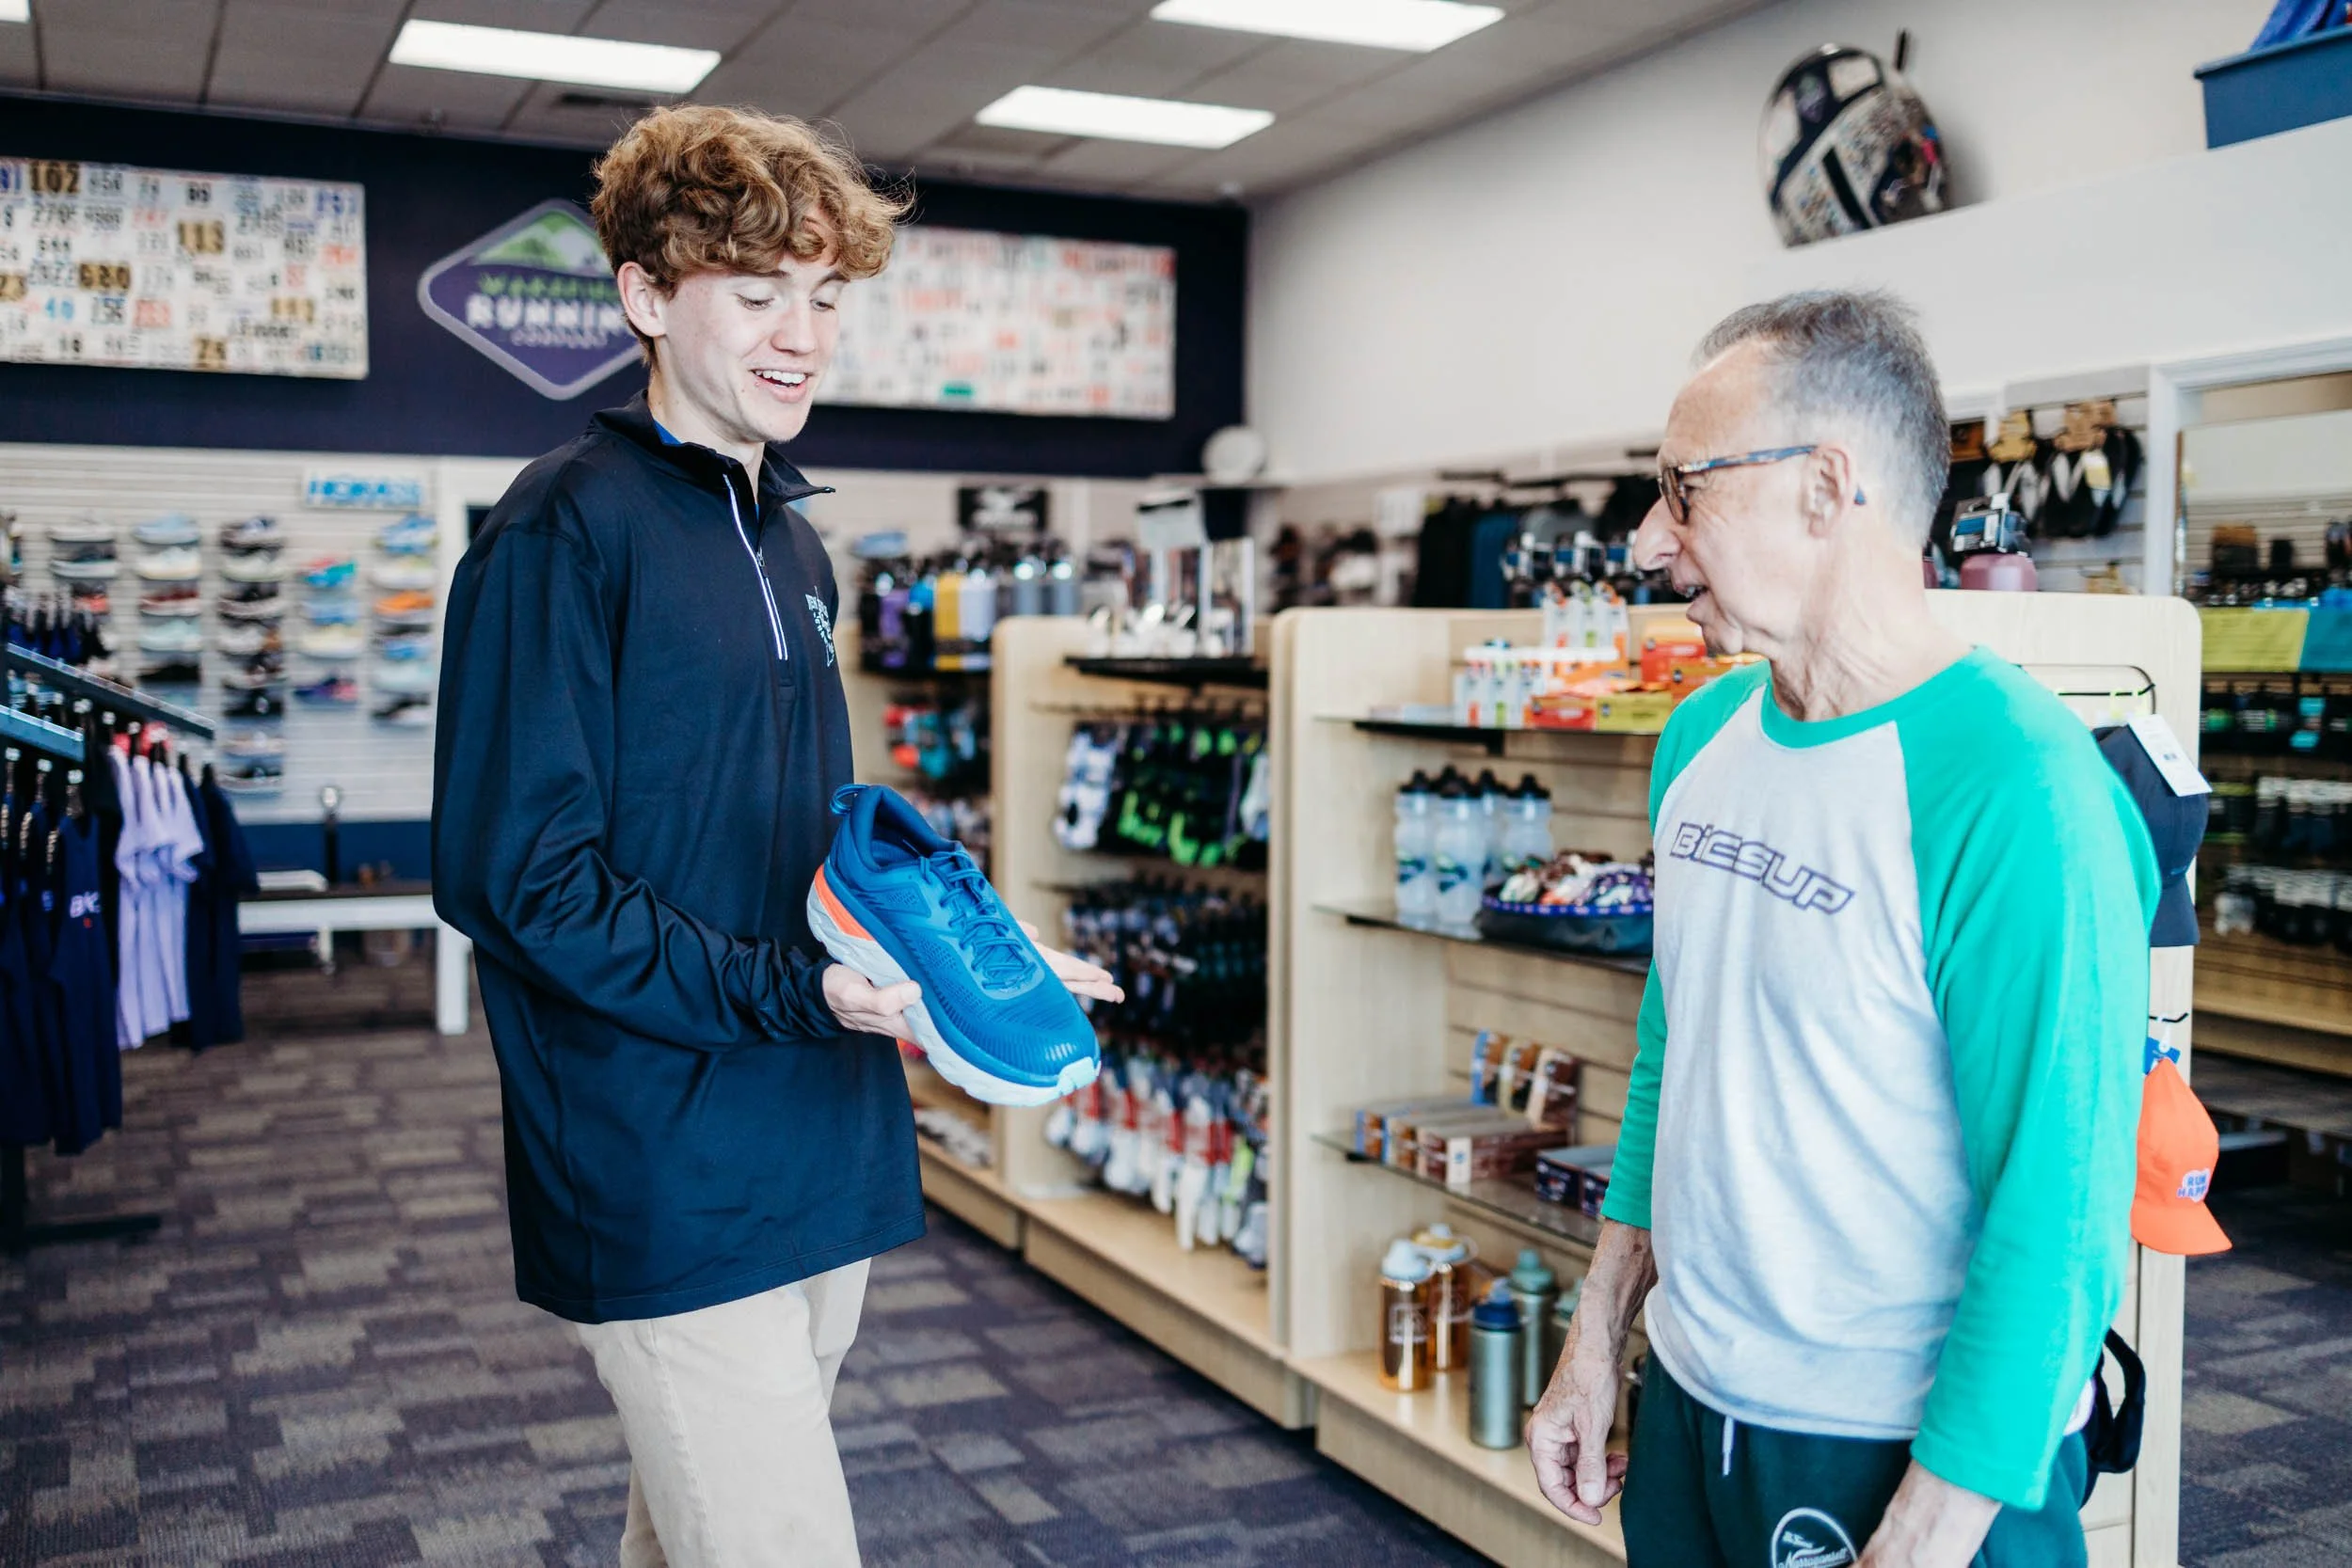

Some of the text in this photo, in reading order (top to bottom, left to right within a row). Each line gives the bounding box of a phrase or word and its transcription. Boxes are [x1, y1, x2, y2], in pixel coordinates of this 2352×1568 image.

[30, 160, 79, 194] 102
[467, 293, 628, 335] RUNNIN
[2178, 1185, 2207, 1196] HAPP
